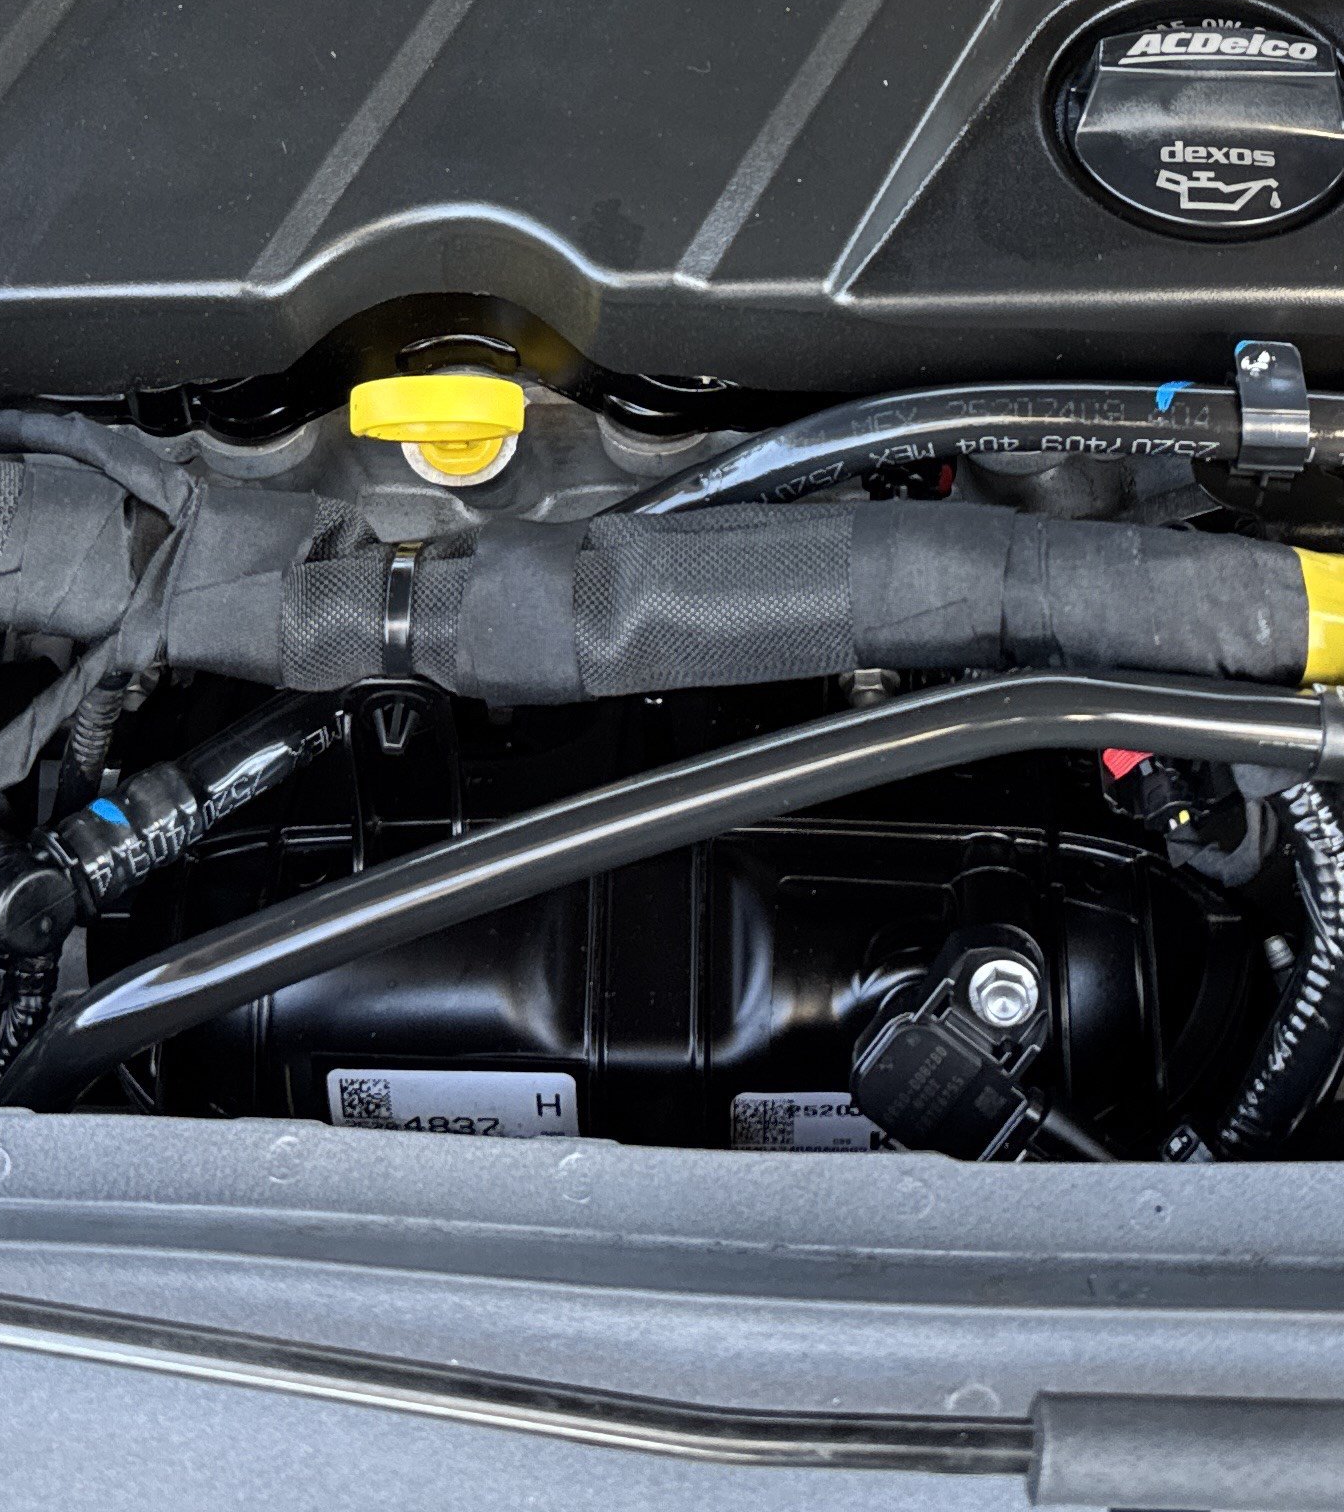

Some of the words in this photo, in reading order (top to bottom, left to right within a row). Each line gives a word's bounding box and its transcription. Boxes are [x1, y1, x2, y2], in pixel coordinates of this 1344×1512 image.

[1126, 32, 1318, 60] ACDelco
[1160, 140, 1276, 168] dexos
[869, 442, 936, 468] MEX
[535, 1092, 562, 1118] H
